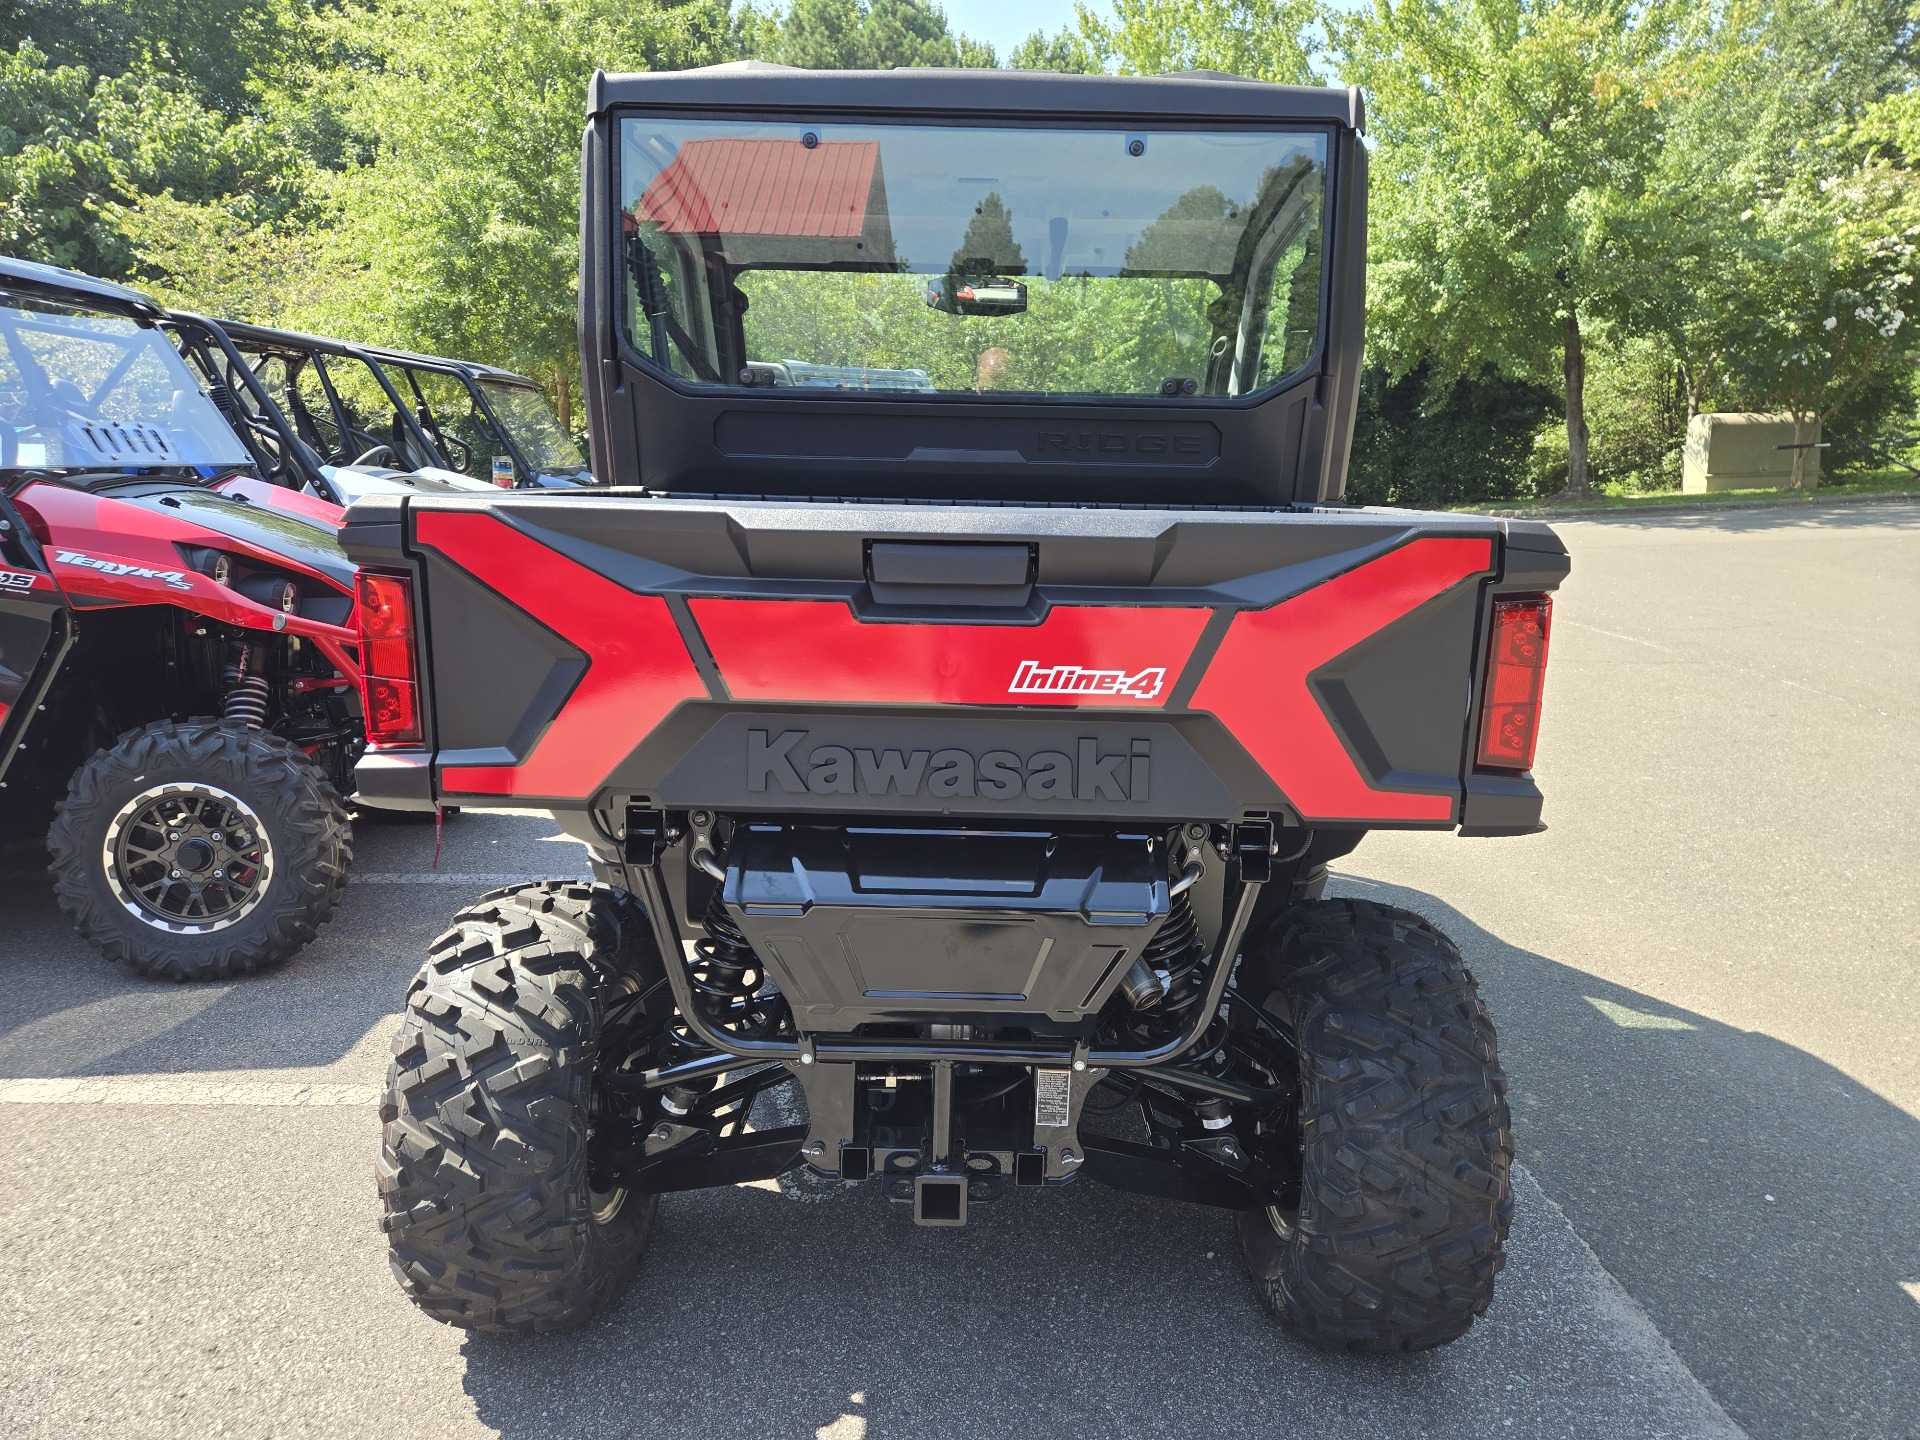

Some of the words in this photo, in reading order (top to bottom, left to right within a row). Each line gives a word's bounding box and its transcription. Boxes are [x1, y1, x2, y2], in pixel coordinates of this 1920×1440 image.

[1038, 432, 1201, 453] RIDGE
[1007, 660, 1167, 699] Inline-4
[747, 728, 1151, 801] Kawasaki
